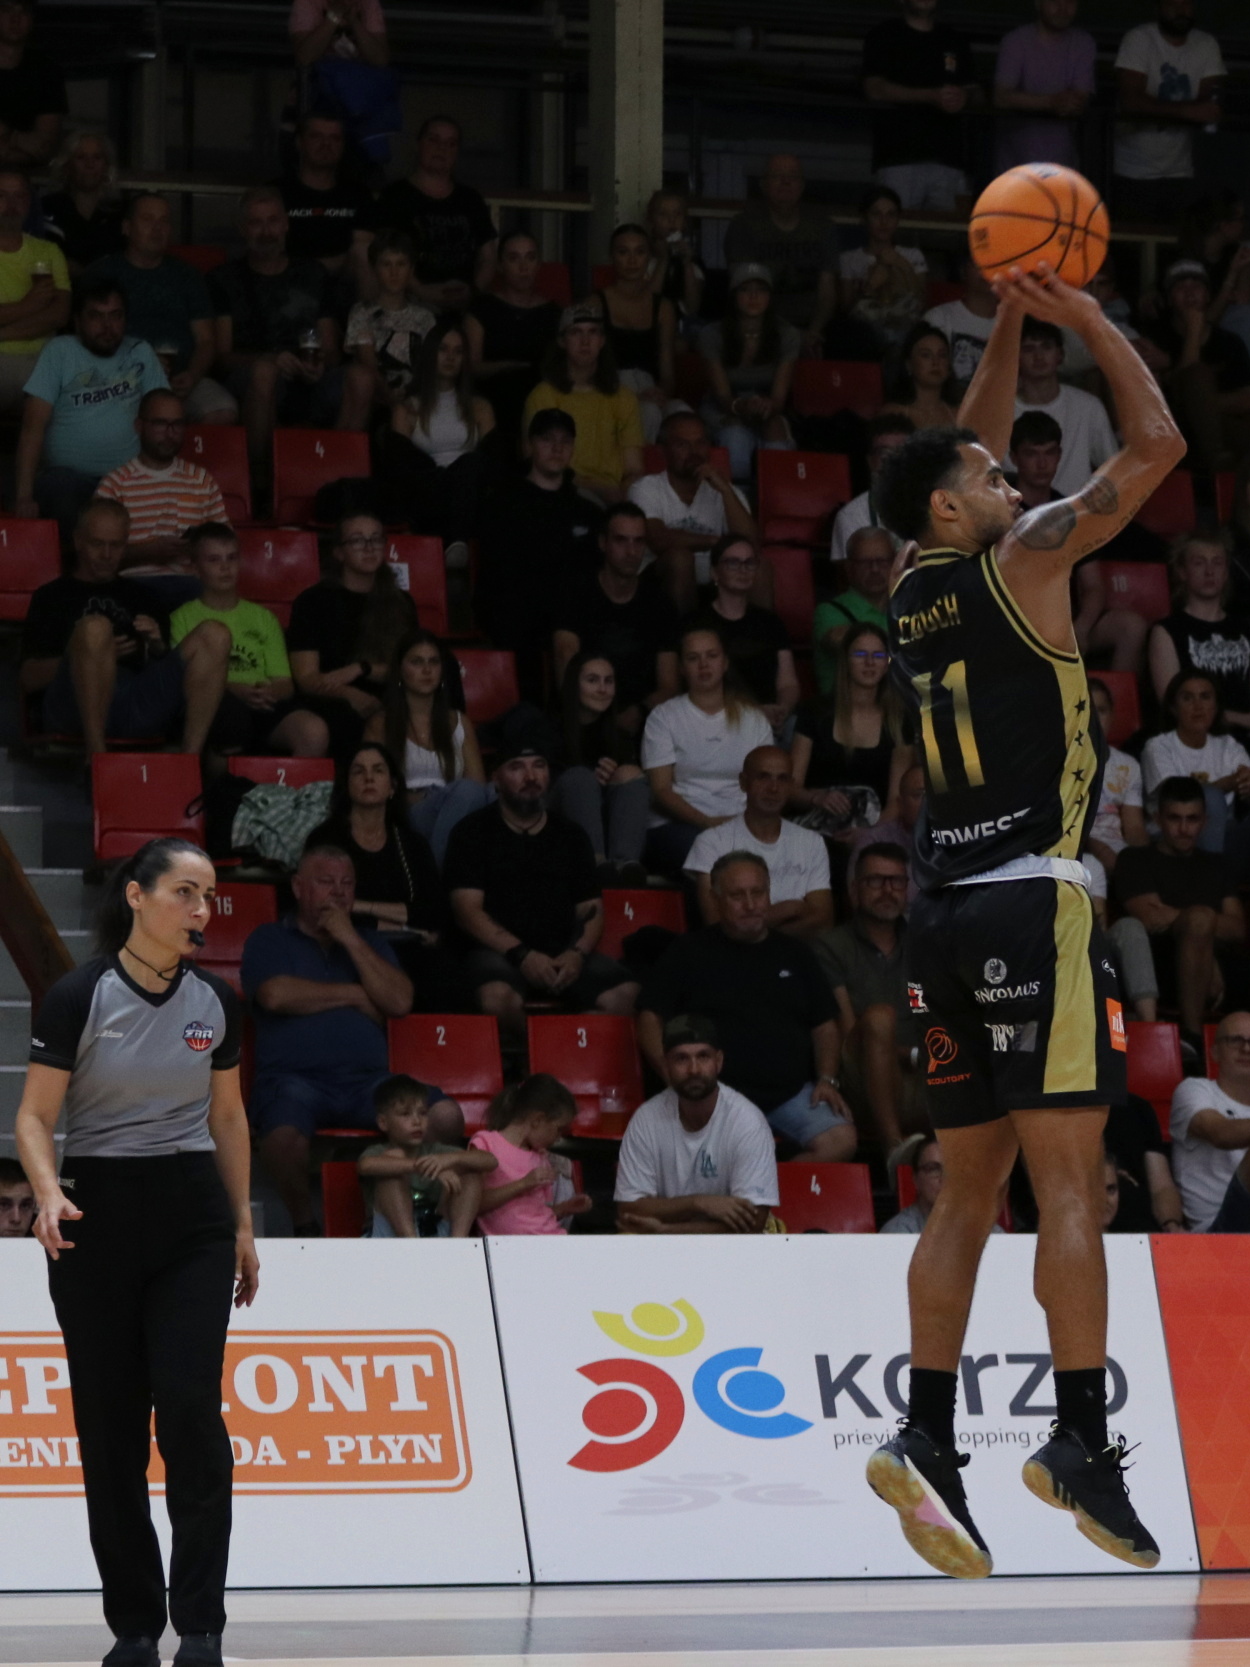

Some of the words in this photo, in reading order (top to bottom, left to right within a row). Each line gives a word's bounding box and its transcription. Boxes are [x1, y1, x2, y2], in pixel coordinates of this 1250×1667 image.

[194, 436, 204, 454] 3
[315, 440, 325, 459] 4
[0, 528, 7, 548] 1
[264, 540, 274, 560] 3
[388, 544, 399, 561] 4
[910, 660, 986, 794] 11
[141, 764, 148, 783] 1
[276, 768, 287, 787] 2
[214, 895, 233, 917] 16
[624, 900, 635, 922] 4
[436, 1025, 447, 1046] 2
[577, 1026, 588, 1048] 3
[809, 1174, 821, 1196] 4
[324, 1434, 443, 1466] PLYN
